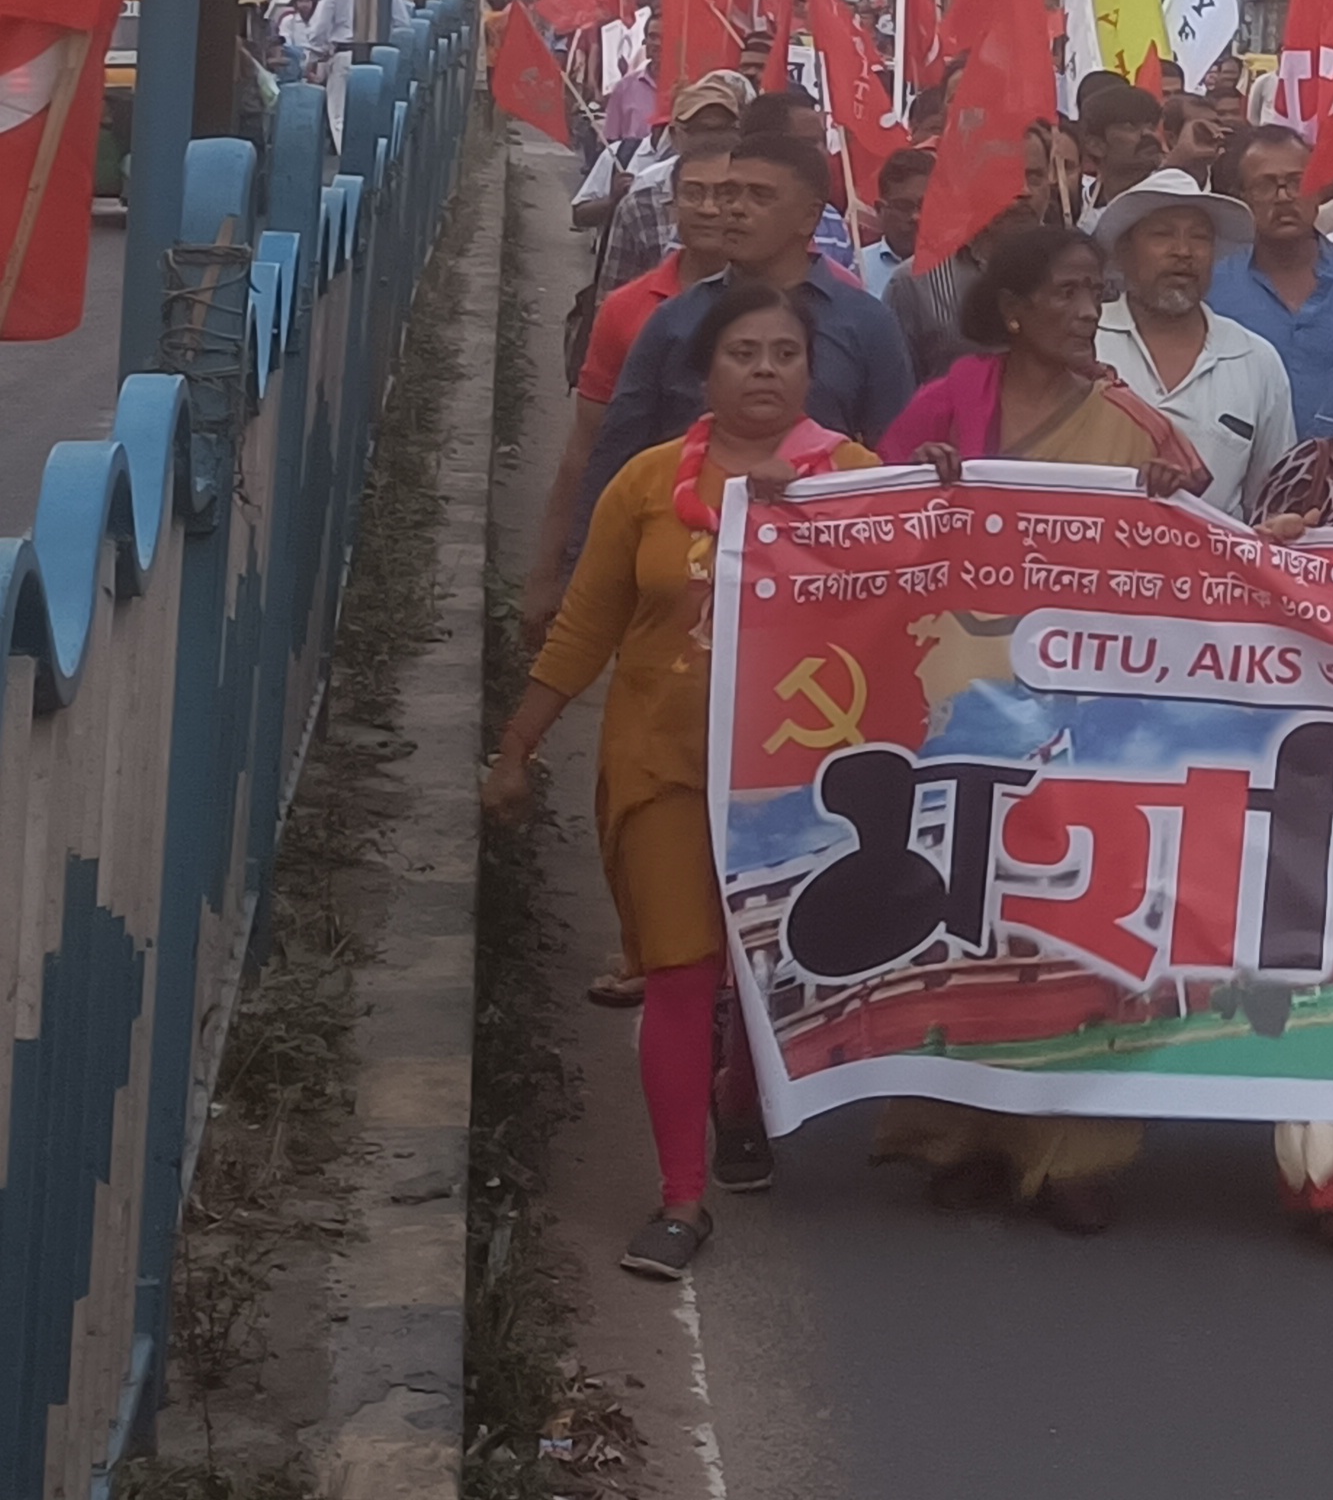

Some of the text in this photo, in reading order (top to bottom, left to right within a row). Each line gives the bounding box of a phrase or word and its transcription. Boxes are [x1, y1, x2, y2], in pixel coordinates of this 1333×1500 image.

[899, 498, 975, 540] বাতিল
[1115, 519, 1201, 548] ২৬০০০
[1207, 524, 1263, 568] টাকা
[789, 570, 891, 603] রেগাতে
[895, 560, 950, 597] বছরে
[960, 560, 1015, 589] ২০০
[1021, 552, 1100, 594] দিনের
[1107, 569, 1164, 599] কাজ
[1171, 576, 1191, 600] ও
[1199, 570, 1272, 608] দৈনিক
[1281, 595, 1332, 624] ৬০০
[1037, 628, 1171, 684] CITU,
[1187, 642, 1302, 684] AIKS
